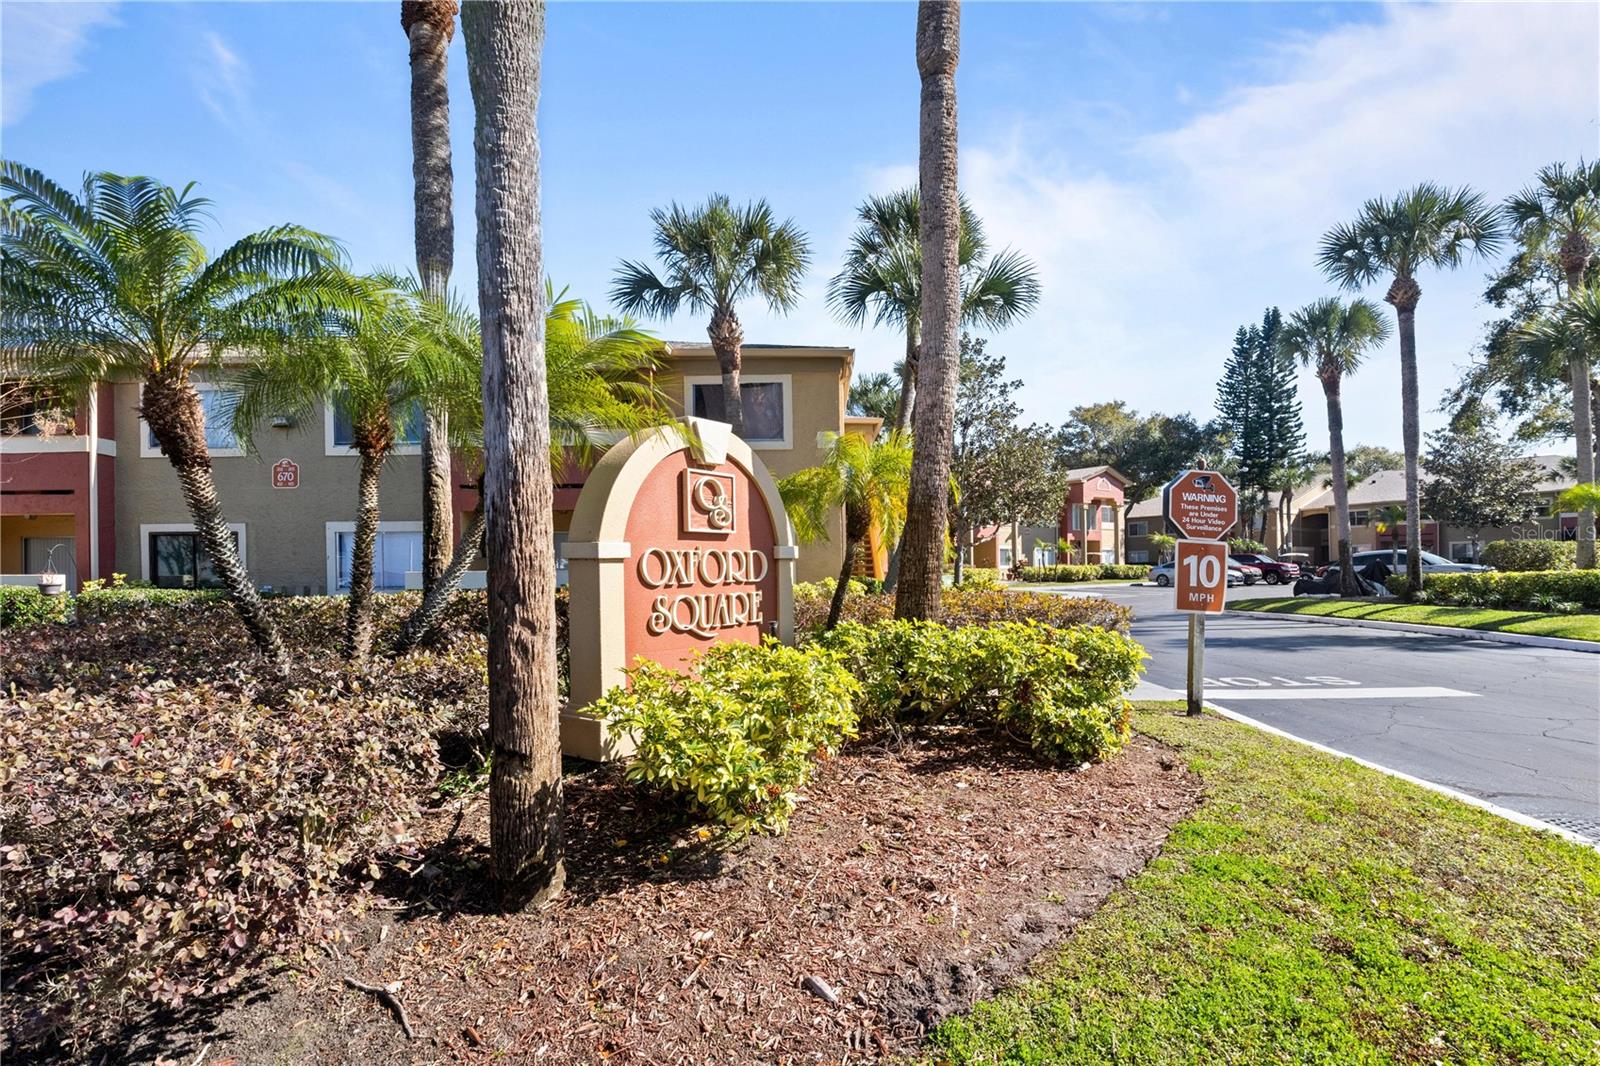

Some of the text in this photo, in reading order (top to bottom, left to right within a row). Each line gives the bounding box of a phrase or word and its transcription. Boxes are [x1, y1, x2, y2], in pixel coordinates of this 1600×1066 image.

[277, 471, 295, 482] 670
[1182, 492, 1227, 503] WARNING
[1186, 523, 1222, 532] Surveillance
[638, 546, 768, 586] OXFORD
[1183, 554, 1221, 588] 10
[1189, 592, 1215, 603] MPH
[649, 590, 763, 638] SQUARE
